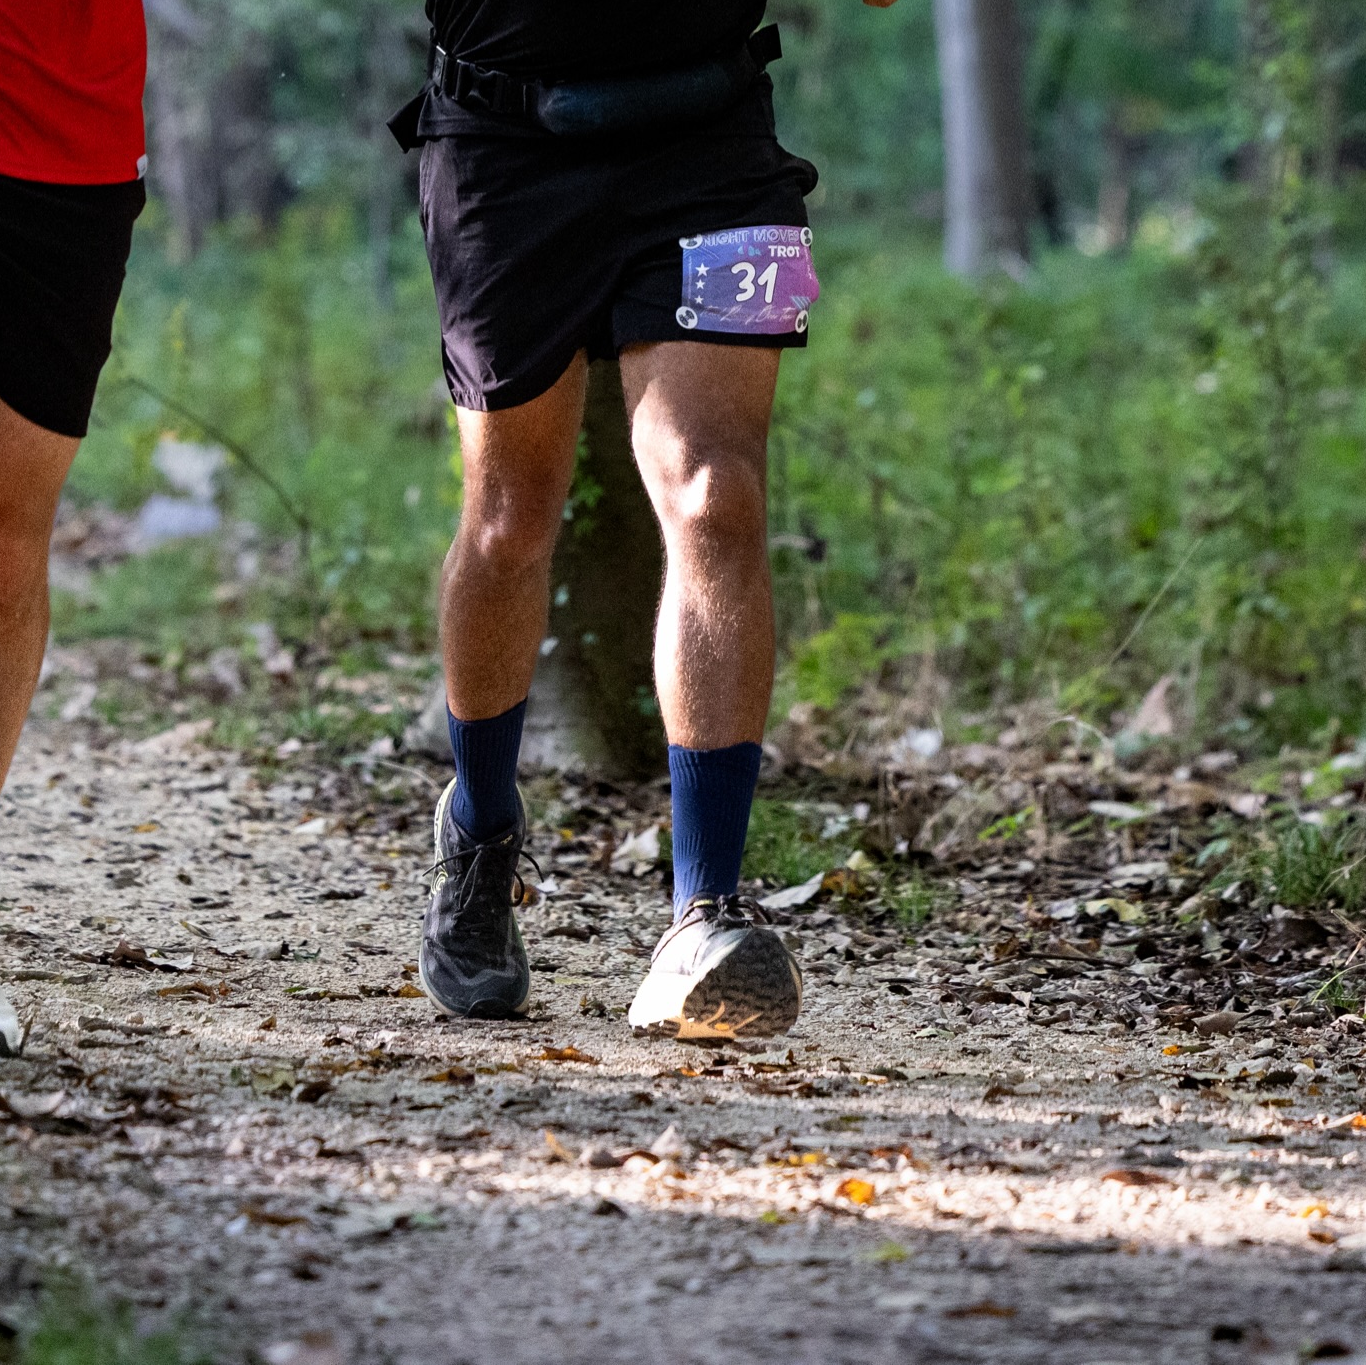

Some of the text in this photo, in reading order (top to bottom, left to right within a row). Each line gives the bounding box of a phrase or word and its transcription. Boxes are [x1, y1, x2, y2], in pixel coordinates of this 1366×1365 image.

[701, 228, 800, 247] NIGHT MOVES
[768, 245, 800, 258] TROT
[731, 261, 779, 304] 31
